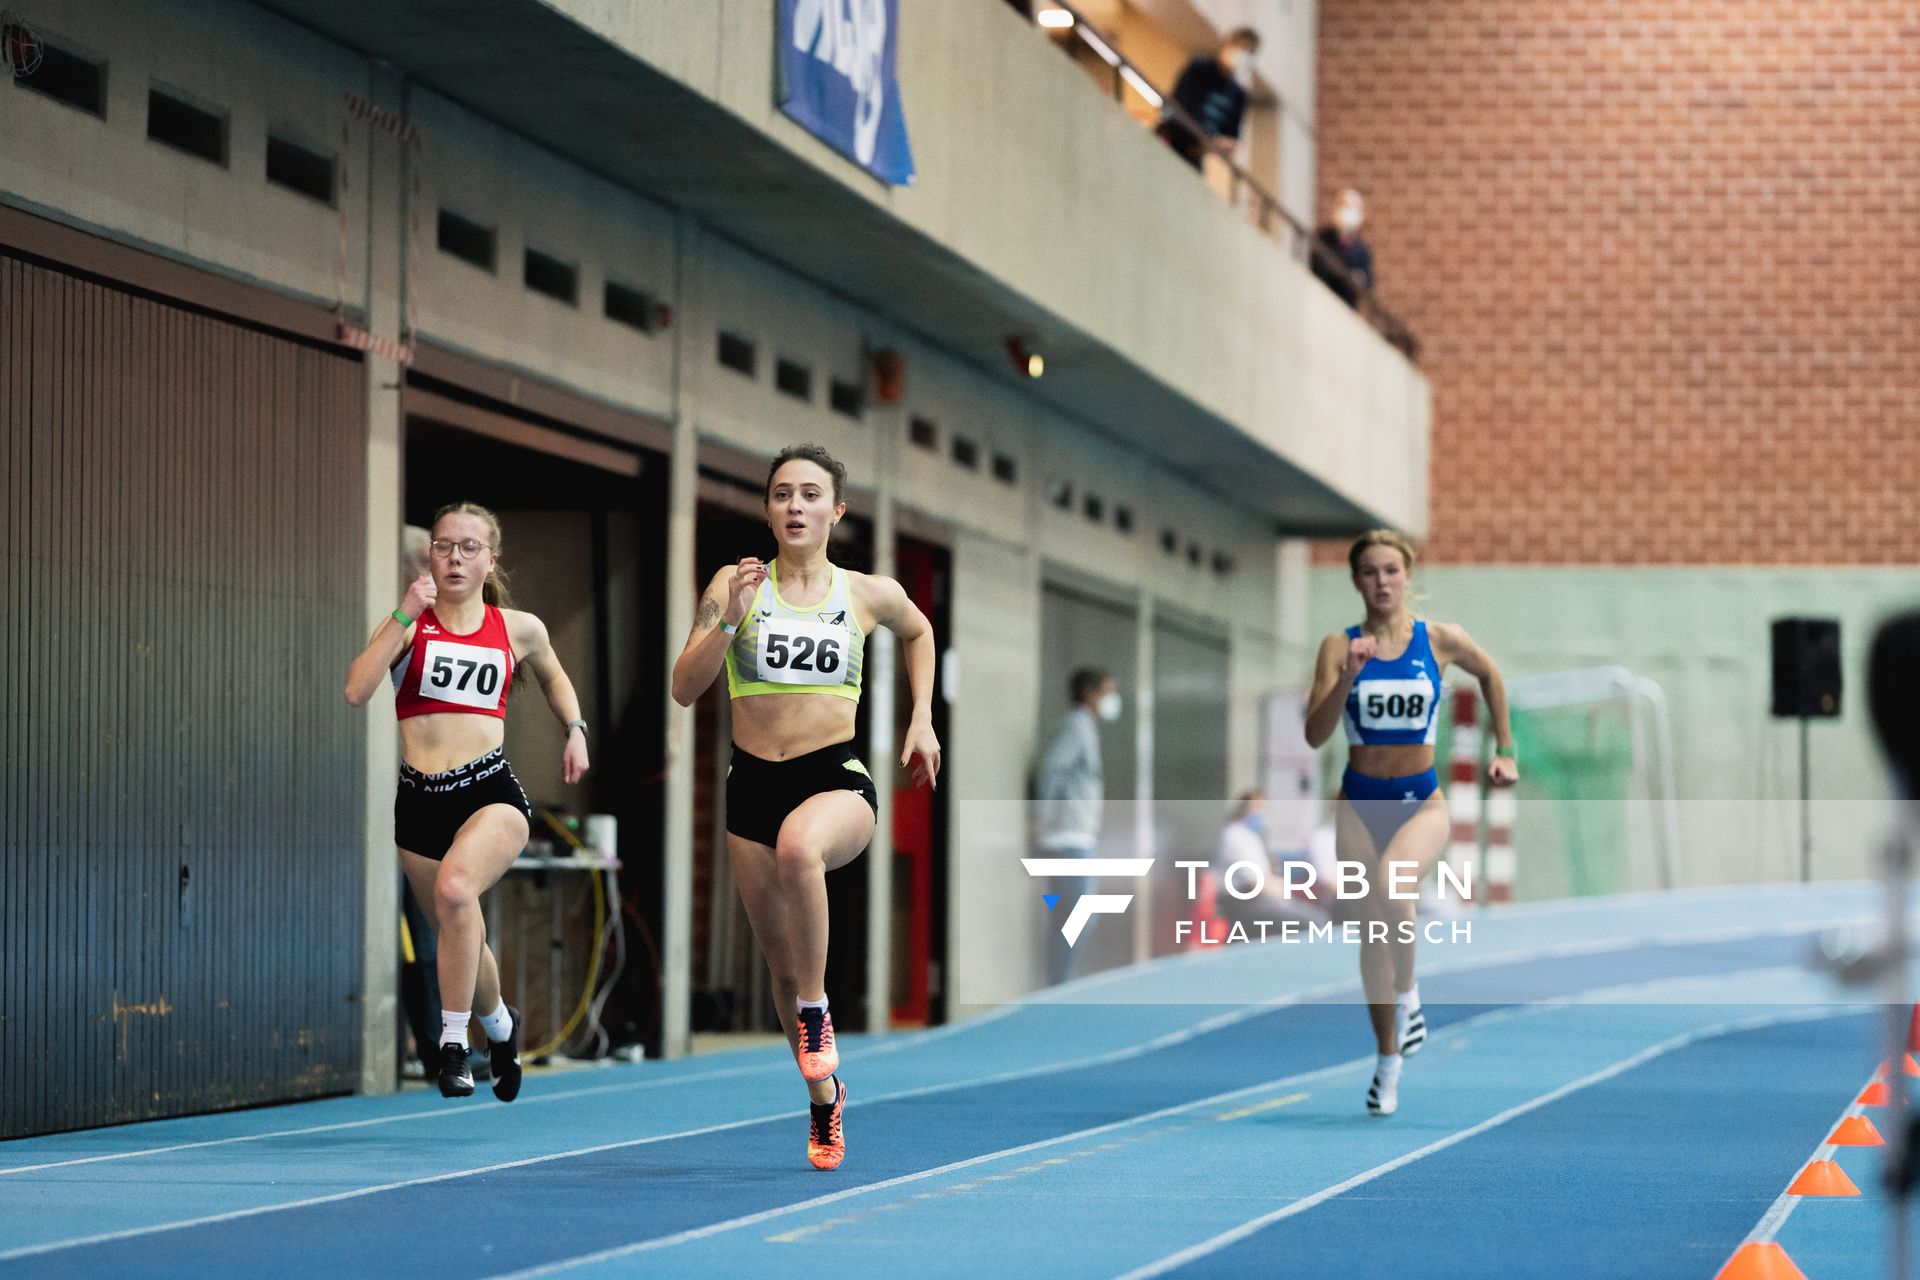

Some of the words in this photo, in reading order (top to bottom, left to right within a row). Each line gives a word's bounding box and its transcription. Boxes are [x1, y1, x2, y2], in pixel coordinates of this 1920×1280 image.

[765, 633, 840, 674] 526
[430, 655, 498, 696] 570
[1366, 693, 1424, 719] 508
